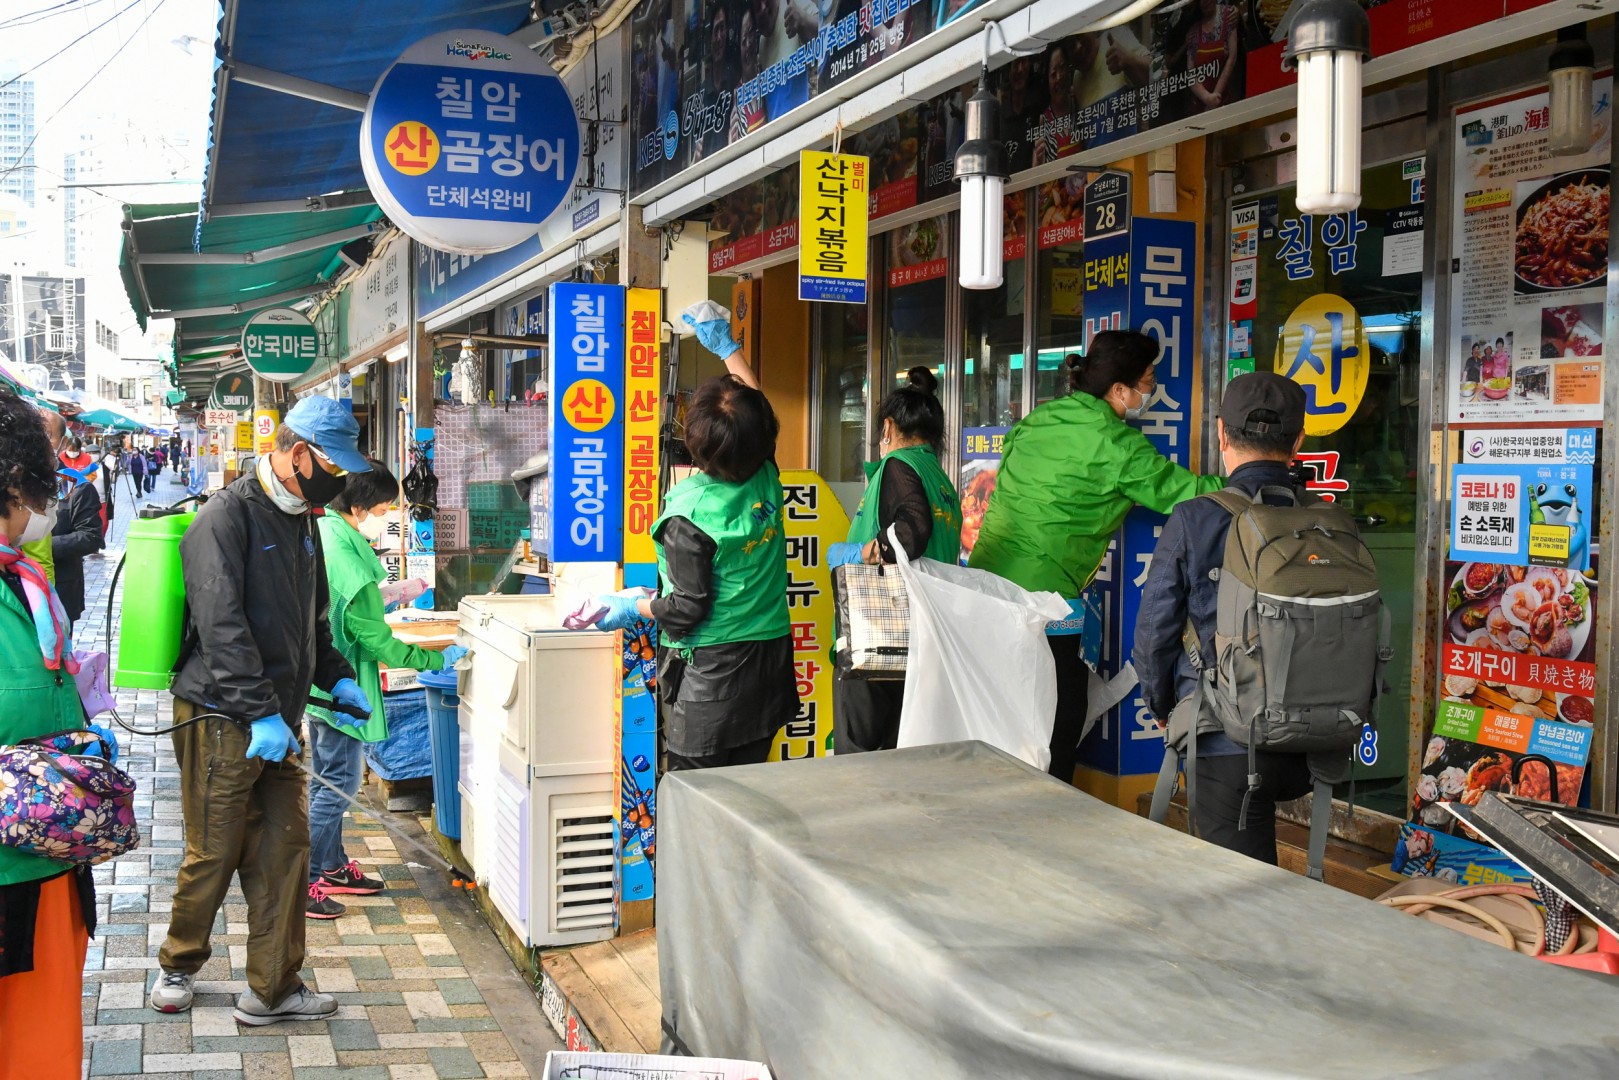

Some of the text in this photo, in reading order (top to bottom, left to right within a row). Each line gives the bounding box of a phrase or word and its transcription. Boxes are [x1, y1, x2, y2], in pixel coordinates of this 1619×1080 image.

[446, 43, 512, 60] Haeundae
[737, 78, 759, 106] 리포터
[788, 27, 827, 79] 조문식이
[827, 11, 858, 56] 추천한
[831, 21, 904, 78] 2014년 7월 25일 방영
[435, 77, 521, 123] 칠암
[1076, 102, 1108, 126] 조문식이
[1111, 90, 1136, 112] 추천한
[1070, 102, 1160, 144] 2015년 7월 25일 방영
[1497, 124, 1523, 139] 釜山の
[388, 126, 432, 168] 산
[442, 130, 565, 181] 곰장어
[639, 126, 663, 171] KBS
[852, 161, 865, 192] 별미
[928, 160, 954, 187] KBS
[427, 185, 531, 213] 단체석완비
[1413, 184, 1425, 195] JC
[816, 158, 849, 273] 산낙지볶음
[1096, 202, 1116, 231] 28
[1235, 210, 1256, 224] VISA
[1393, 220, 1406, 229] CCTV
[768, 222, 796, 248] 소금구이
[1276, 206, 1368, 281] 칠암
[712, 245, 735, 269] 양념구이
[1085, 252, 1129, 291] 단체석
[246, 334, 316, 358] 한국마트
[570, 293, 610, 372] 칠암
[629, 311, 658, 378] 칠암
[1285, 311, 1360, 415] 산
[209, 411, 234, 424] 옷수선
[568, 386, 607, 424] 산
[629, 390, 657, 423] 산
[258, 419, 271, 434] 냉
[1489, 436, 1562, 447] (사)한국외식업중앙회
[1489, 448, 1562, 458] 해운대구지부 회원업소
[1568, 433, 1593, 449] 대선
[569, 437, 609, 553] 곰장어
[628, 436, 657, 536] 곰장어
[1461, 482, 1515, 499] 코로나 19
[1468, 501, 1507, 512] 예방을 위한
[1460, 515, 1515, 533] 손 소독제
[1461, 534, 1513, 547] 비치업소입니다
[1450, 649, 1595, 691] 조개구이 貝焼き物
[1445, 705, 1476, 722] 조개구이
[1494, 714, 1519, 730] 해물탕
[1483, 725, 1524, 740] Spicy Seafood Stew
[1538, 723, 1585, 744] 양념곰장어
